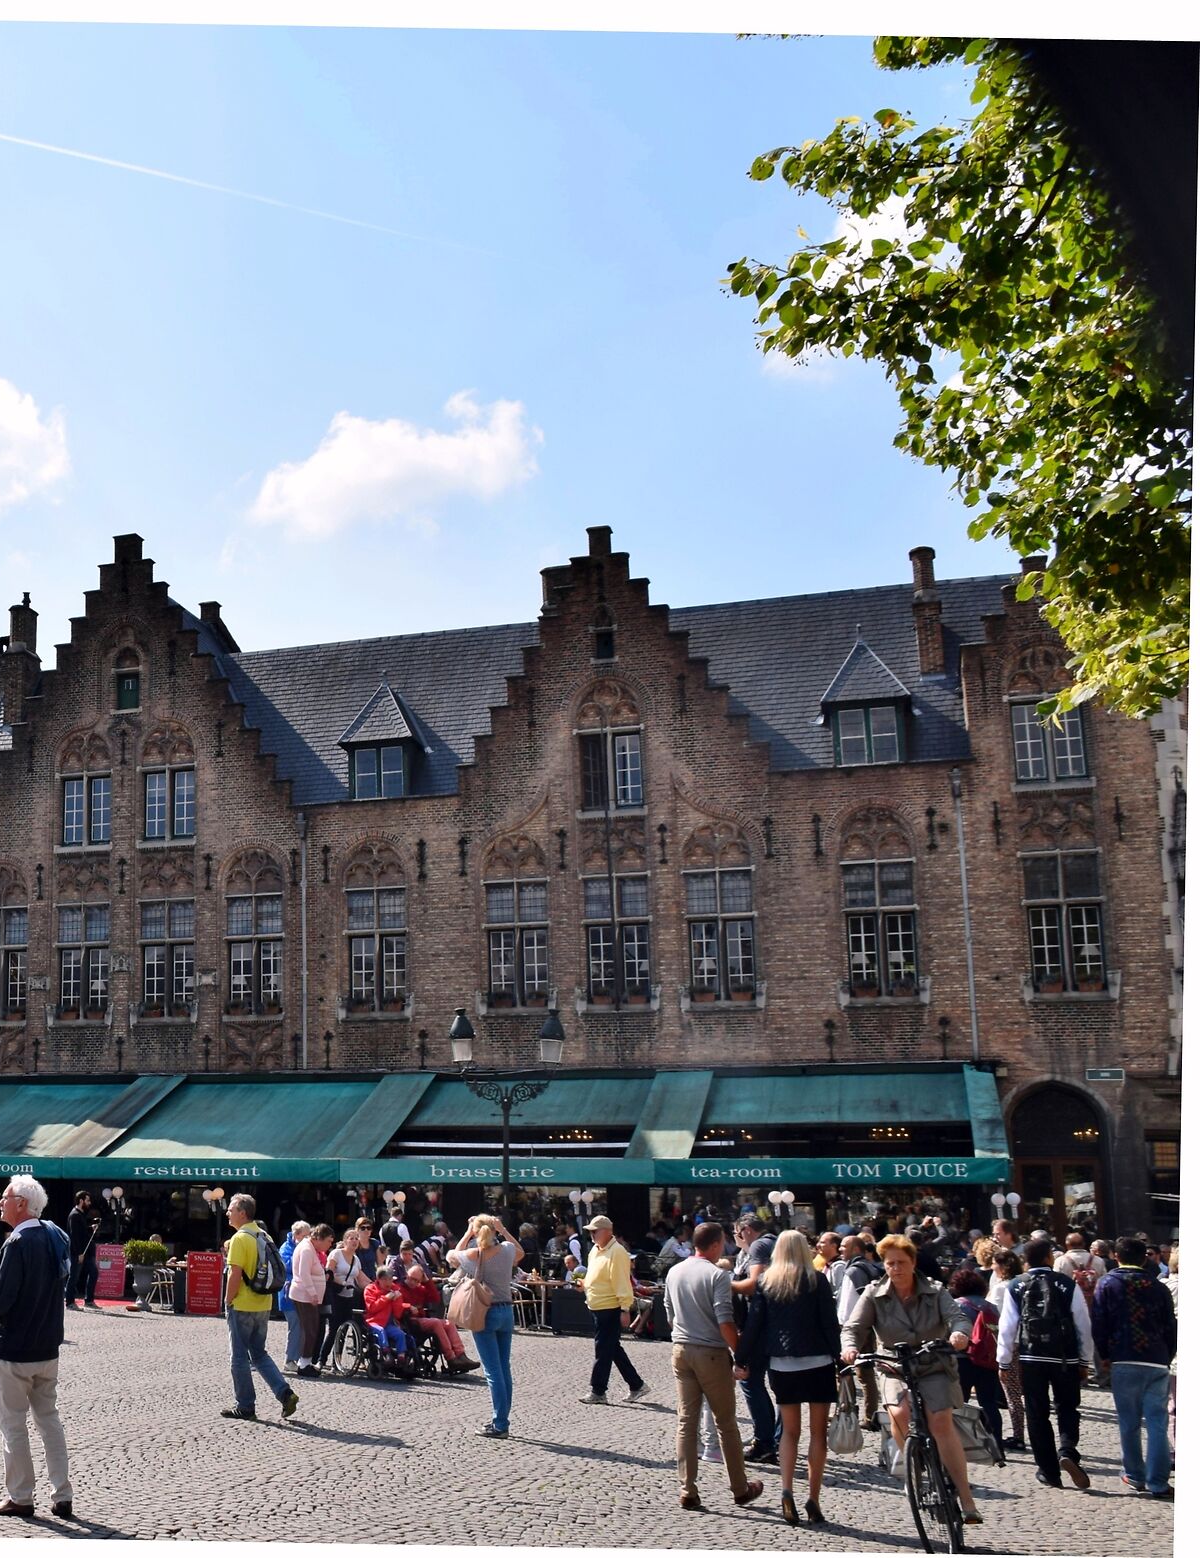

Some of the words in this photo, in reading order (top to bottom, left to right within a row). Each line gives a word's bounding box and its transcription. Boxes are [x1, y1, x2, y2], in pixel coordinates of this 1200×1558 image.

[133, 1164, 261, 1177] restaurant
[430, 1164, 555, 1178] brasserie
[690, 1165, 782, 1178] tea-room
[832, 1163, 882, 1178] TOM
[892, 1163, 969, 1178] POUCE
